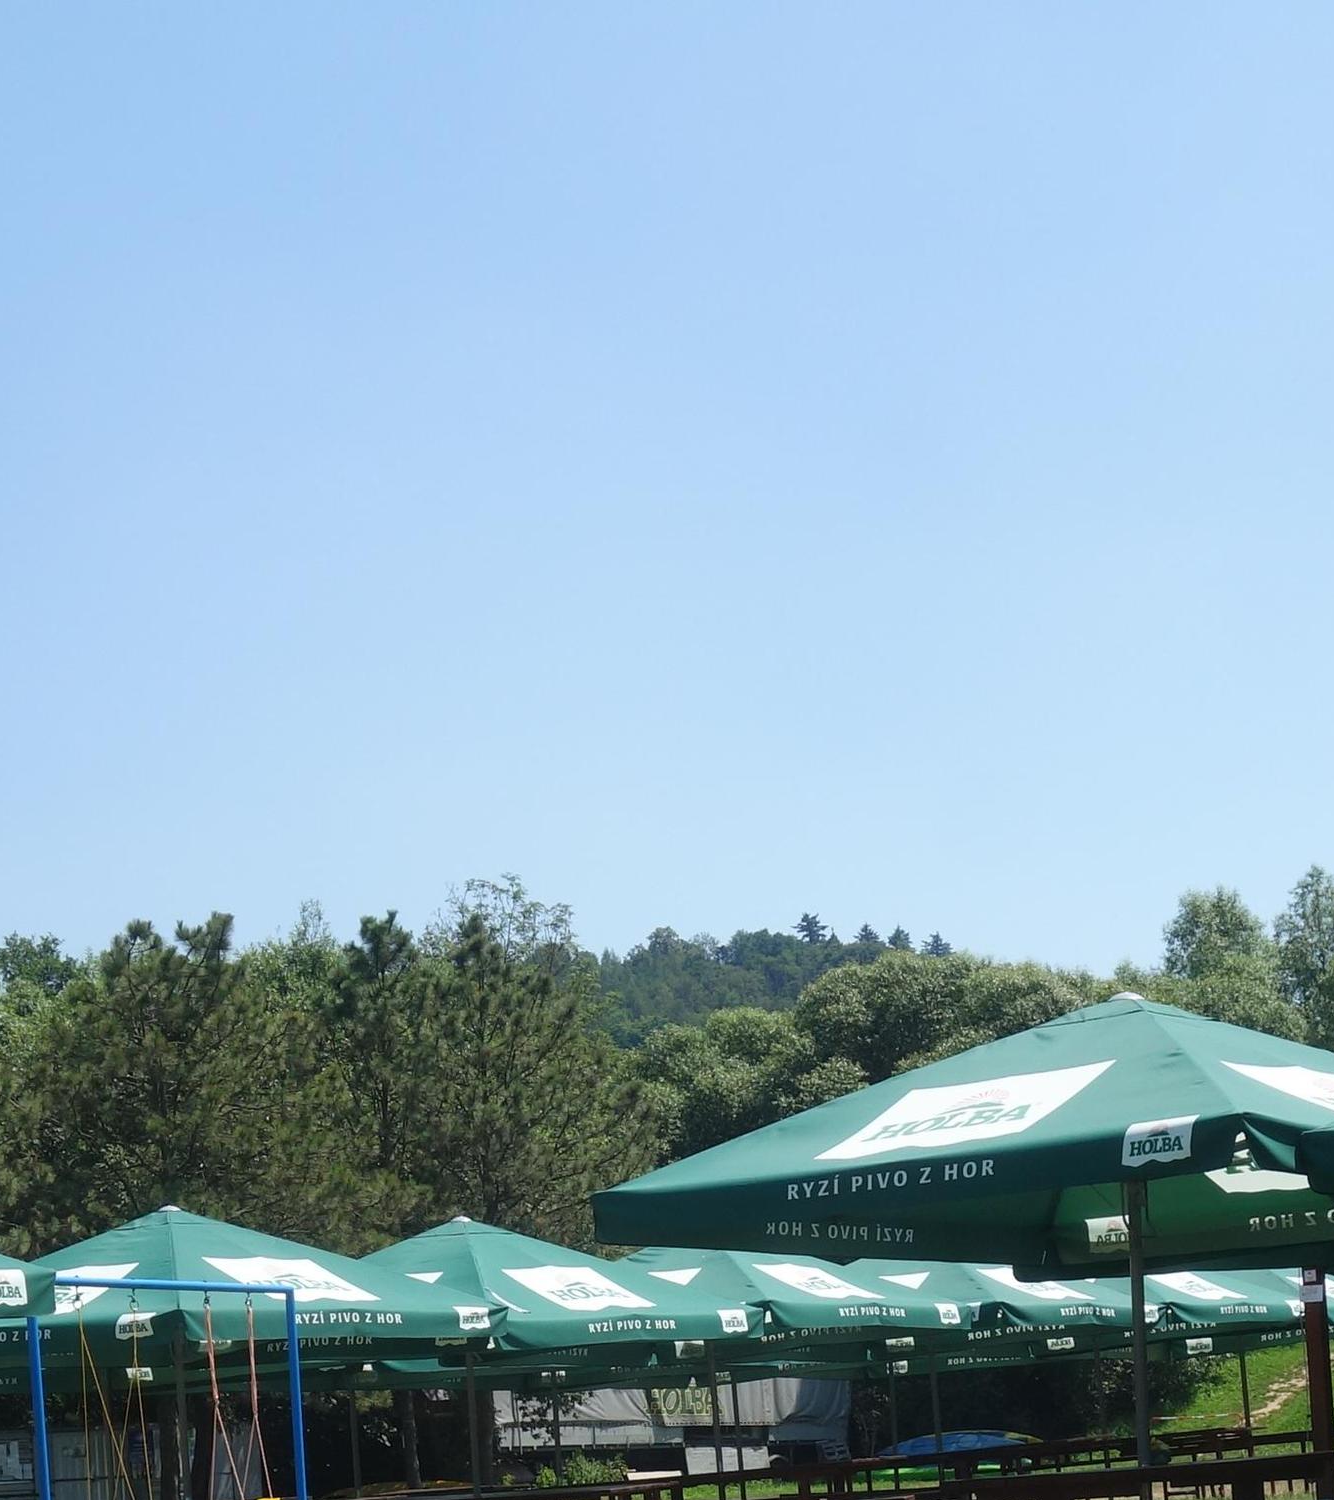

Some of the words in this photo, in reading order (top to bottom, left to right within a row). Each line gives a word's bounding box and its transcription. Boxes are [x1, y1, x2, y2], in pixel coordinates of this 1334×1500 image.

[861, 1104, 1033, 1142] HOLBA
[1129, 1136, 1183, 1156] HOLBA
[788, 1175, 840, 1200] RYZÍ
[851, 1171, 908, 1192] PIVO
[920, 1167, 932, 1184] Z
[944, 1159, 995, 1181] HOR
[294, 1311, 324, 1324] RYZÍ
[330, 1312, 360, 1323] PIVO
[365, 1313, 372, 1323] Z
[377, 1312, 402, 1324] HOR
[588, 1319, 613, 1333] RYZÍ
[617, 1320, 641, 1331] PIVO
[645, 1320, 652, 1330] Z
[655, 1319, 676, 1329] HOR
[12, 1331, 19, 1341] Z
